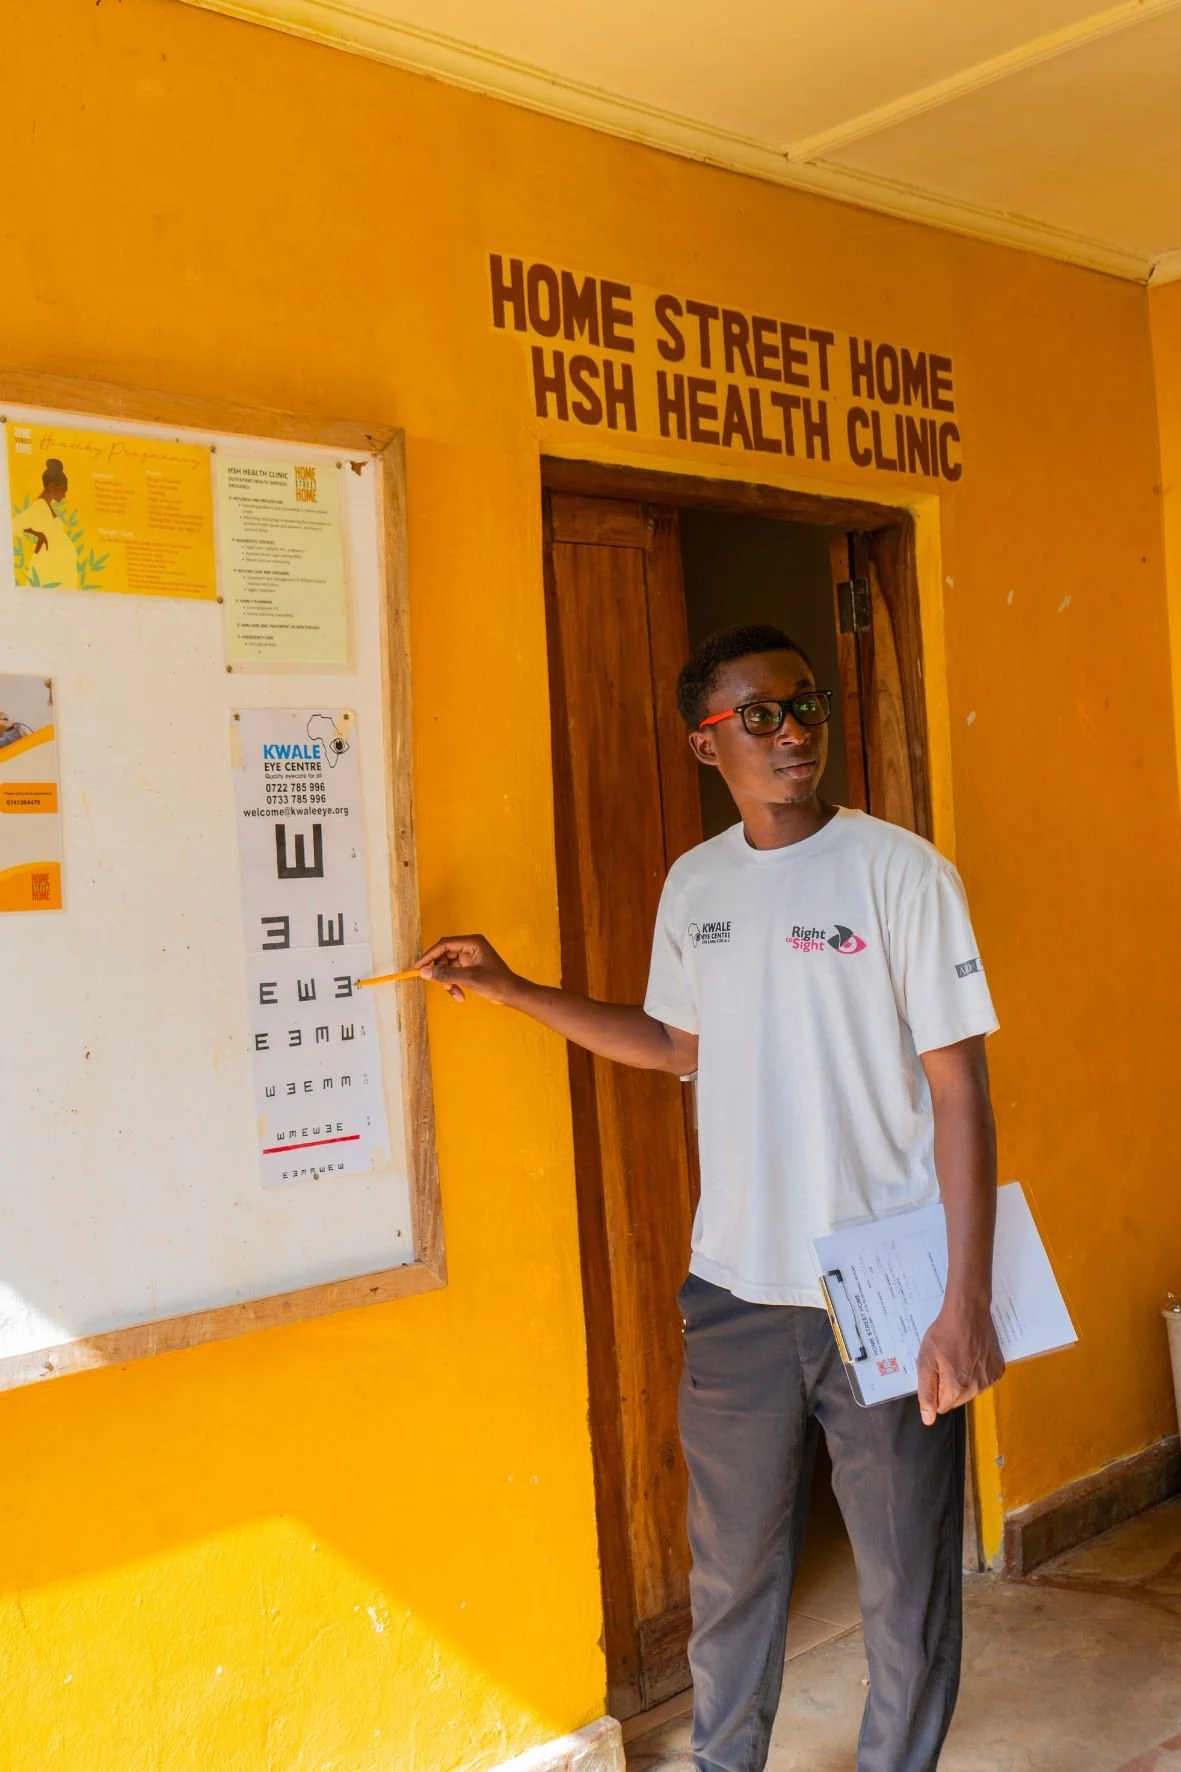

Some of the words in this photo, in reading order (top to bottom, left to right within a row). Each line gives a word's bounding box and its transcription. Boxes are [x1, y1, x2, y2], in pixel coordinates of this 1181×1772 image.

[489, 253, 634, 353] HOME
[655, 294, 834, 391] STREET
[849, 336, 954, 413] HOME
[531, 345, 637, 432] HSH
[656, 370, 830, 461] HEALTH
[847, 406, 962, 482] CLINIC
[242, 468, 268, 477] HEALTH
[269, 471, 289, 480] CLINIC
[295, 465, 316, 480] HOME
[296, 488, 317, 503] HOME
[263, 744, 321, 760] KWALE
[264, 762, 282, 772] EYE
[284, 761, 321, 771] CENTRE
[265, 783, 288, 793] 0722
[292, 783, 307, 792] 785
[309, 782, 325, 791] 996
[266, 795, 289, 805] 0733
[292, 795, 308, 804] 785
[309, 794, 326, 804] 996
[243, 806, 349, 819] welcome@kwaleeye.org
[702, 921, 731, 933] KWALE
[791, 926, 826, 942] Right
[792, 938, 825, 953] Sight
